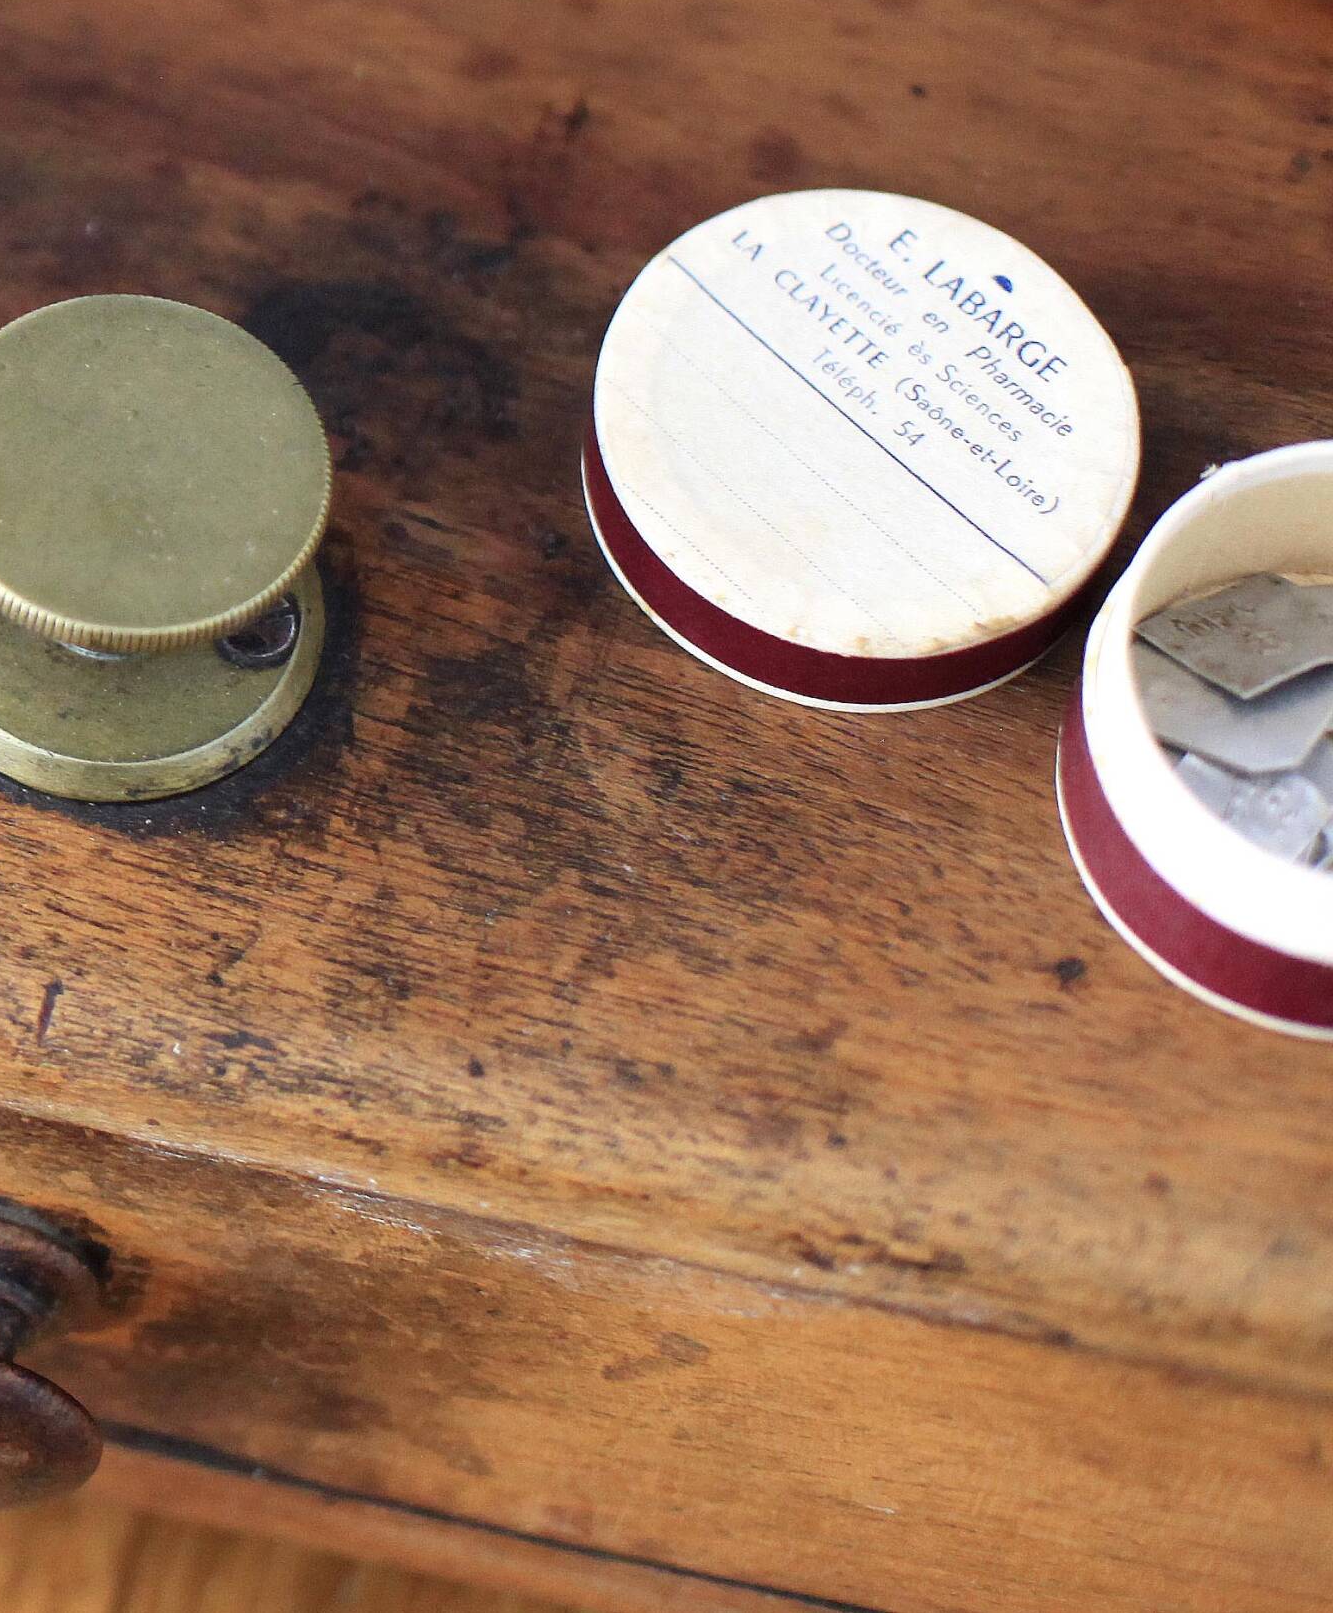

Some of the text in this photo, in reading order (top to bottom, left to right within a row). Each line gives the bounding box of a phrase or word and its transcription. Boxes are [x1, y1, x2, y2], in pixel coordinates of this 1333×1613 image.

[732, 230, 1059, 514] LA CLAYETTE (Saône-et-Loire)
[820, 263, 1022, 442] Licencié ès Sciences
[825, 222, 1074, 437] Docteur en Pharmacie
[889, 229, 1068, 383] E. LABARGE
[813, 348, 926, 447] Téléph. 54
